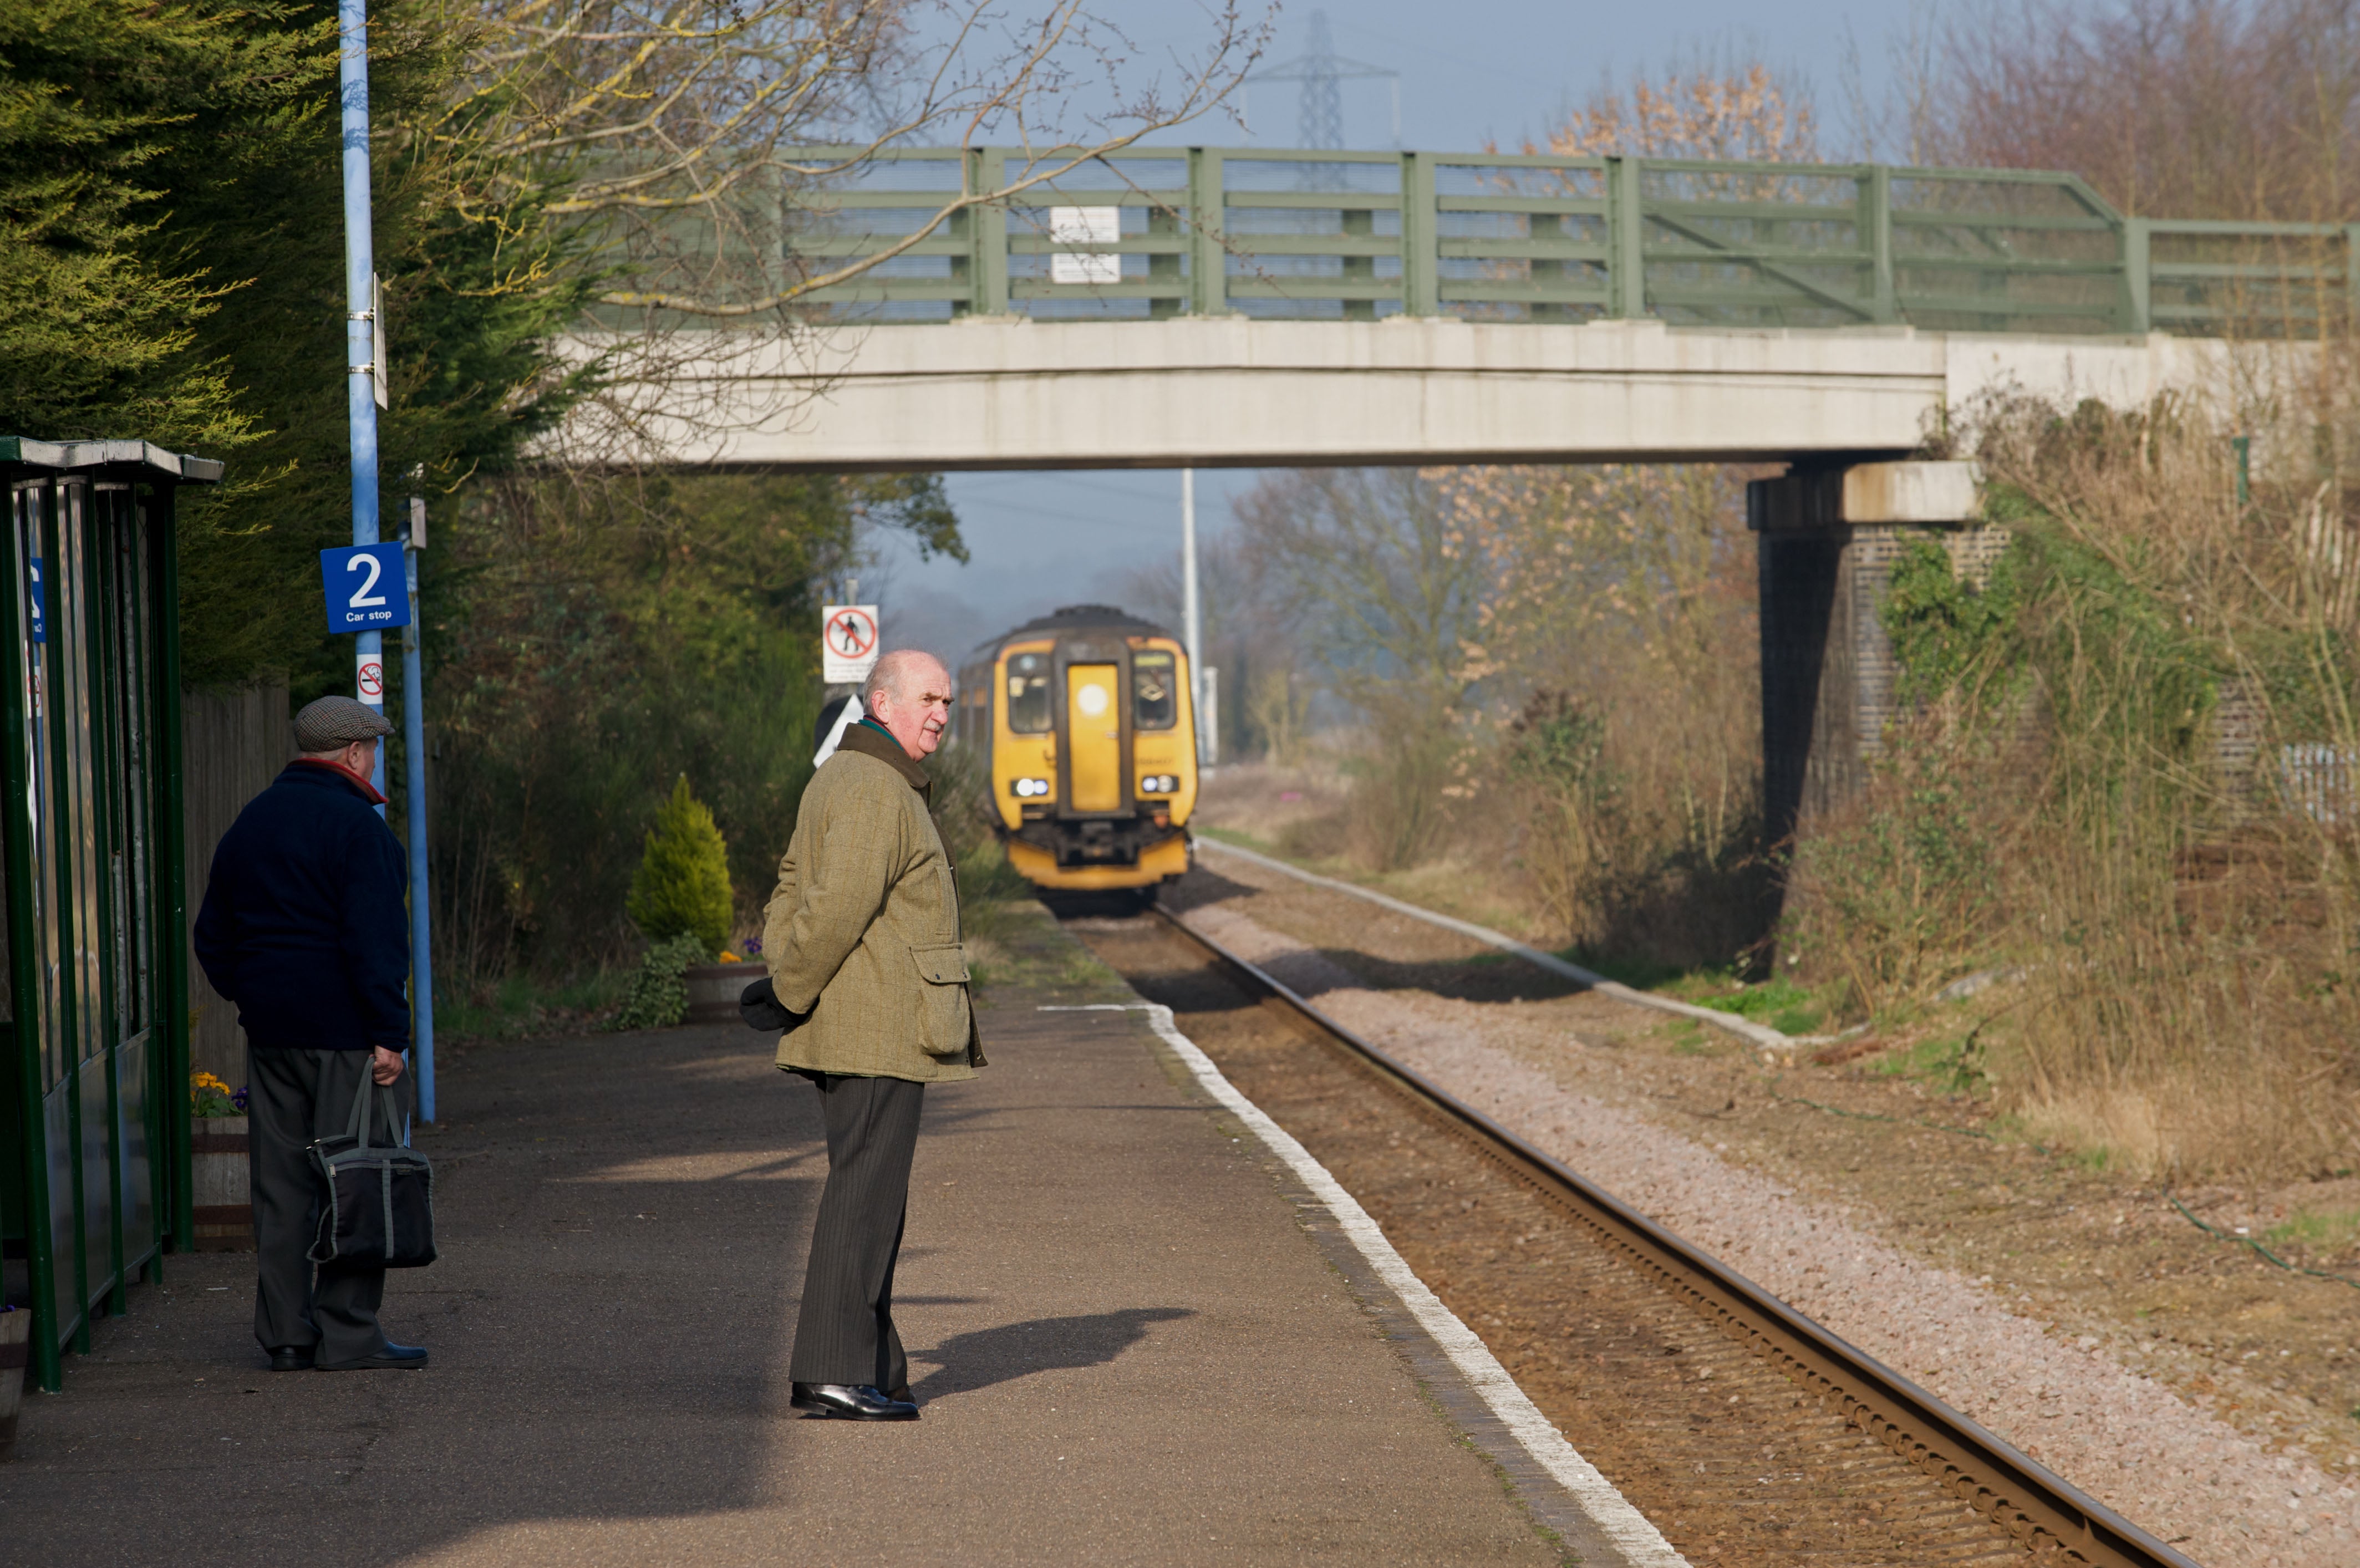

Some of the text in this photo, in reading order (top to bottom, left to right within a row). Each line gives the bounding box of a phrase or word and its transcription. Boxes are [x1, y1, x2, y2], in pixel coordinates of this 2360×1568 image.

[347, 553, 385, 608] 2
[346, 611, 391, 622] Car stop
